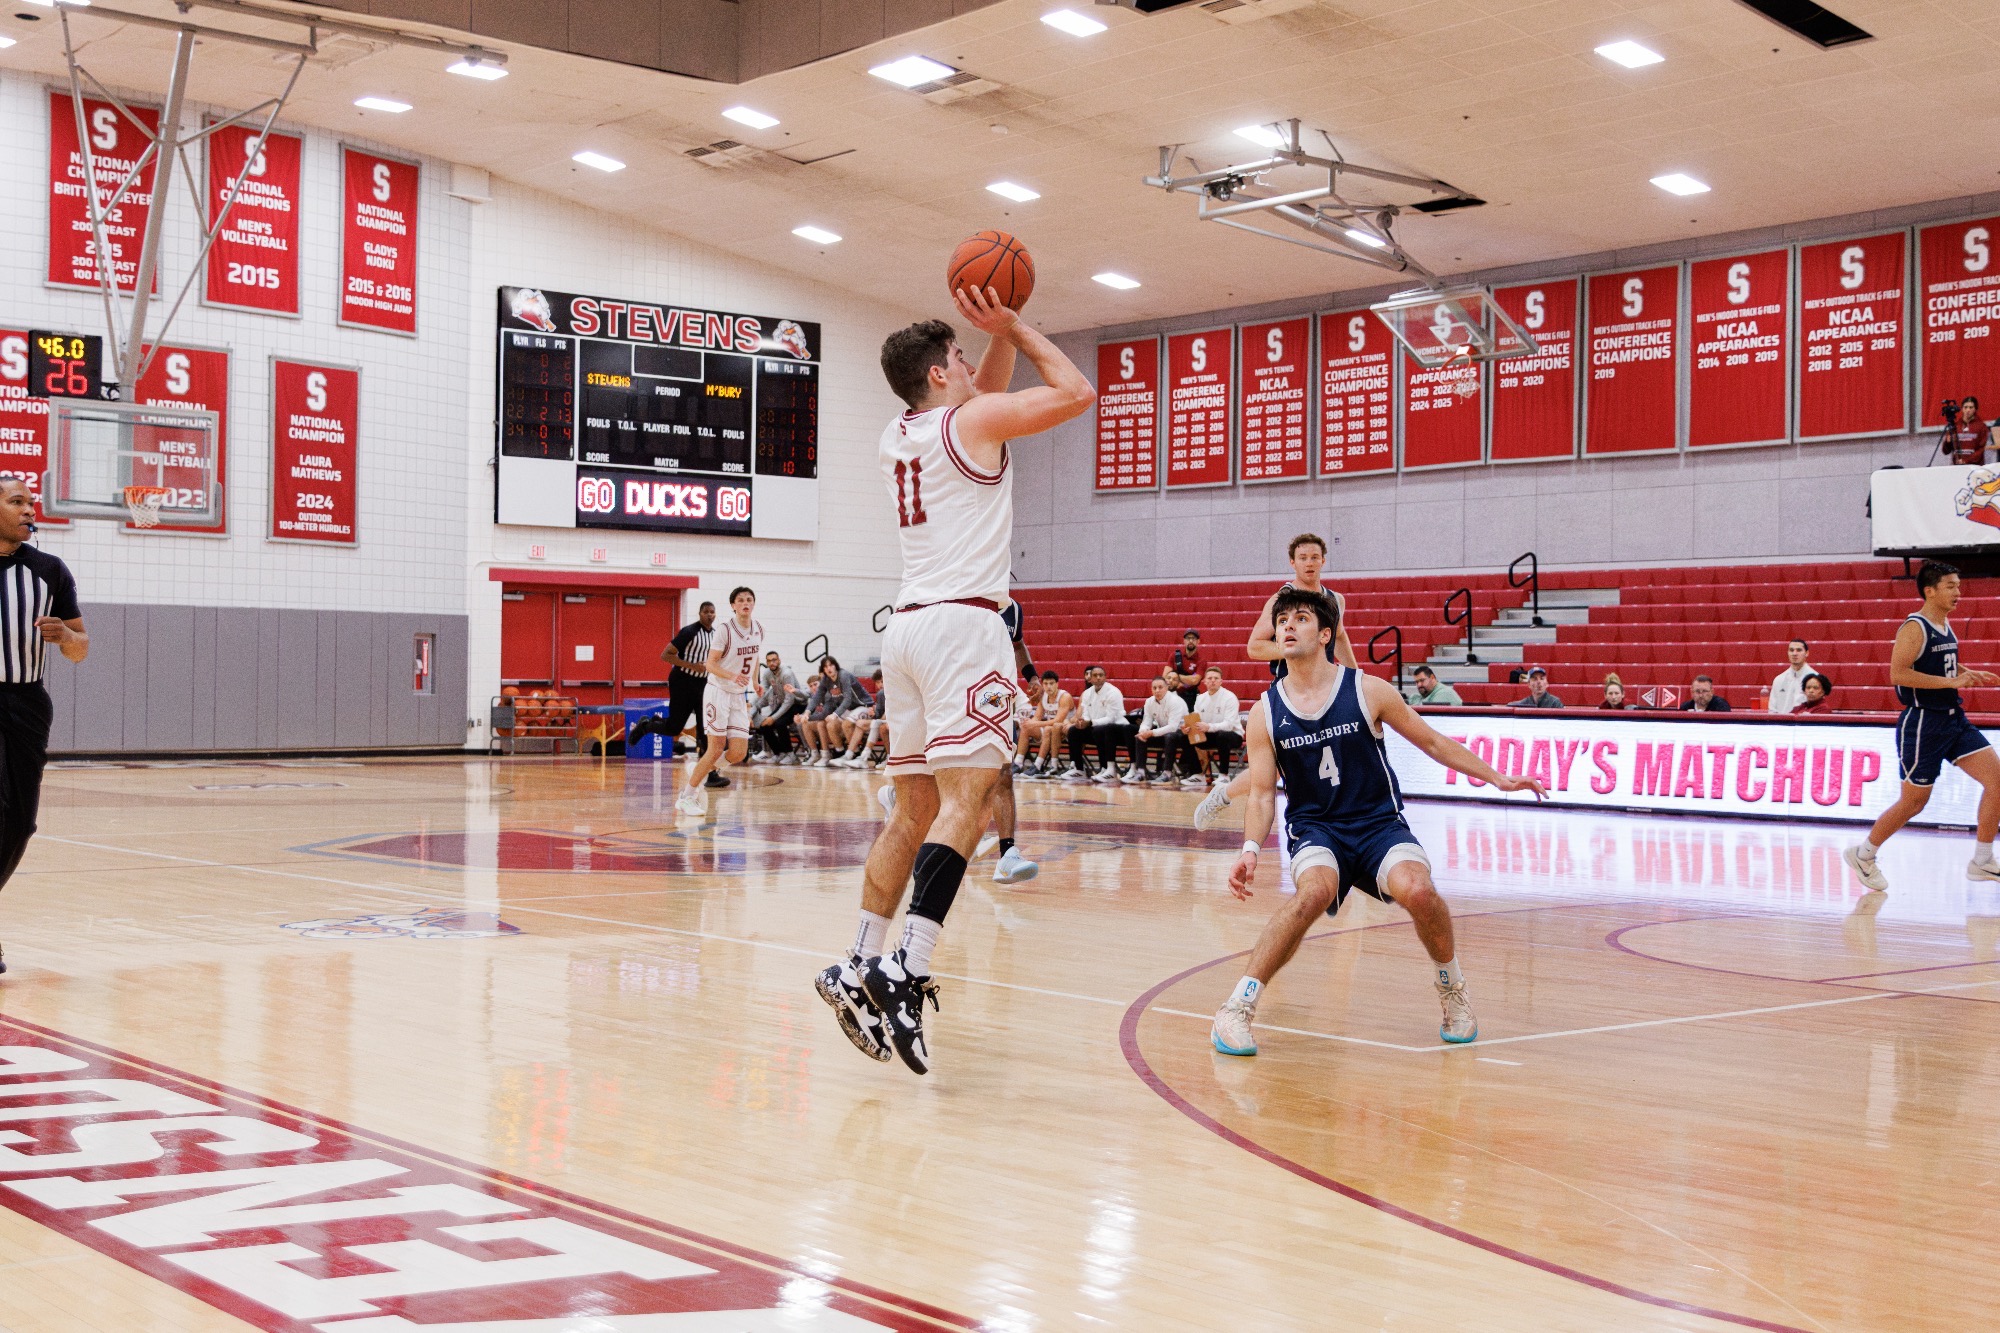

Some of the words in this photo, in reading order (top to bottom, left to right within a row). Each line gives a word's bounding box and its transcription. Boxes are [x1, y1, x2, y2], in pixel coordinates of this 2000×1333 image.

[92, 108, 118, 150] S
[244, 135, 267, 176] S
[372, 163, 391, 202] S
[357, 202, 405, 223] NATIONAL
[237, 218, 272, 235] MEN'S
[356, 214, 407, 236] CHAMPION
[221, 229, 288, 250] VOLLEYBALL
[363, 241, 398, 259] GLADYS
[1963, 227, 1989, 272] S
[72, 256, 93, 267] 200
[366, 254, 395, 271] NJOKU
[1840, 246, 1864, 290] S
[73, 269, 92, 280] 100
[227, 262, 280, 289] 2015
[1727, 262, 1750, 305] S
[347, 276, 375, 294] 2015
[376, 285, 384, 296] &
[385, 283, 412, 302] 2016
[1623, 278, 1643, 317] S
[345, 294, 374, 308] INDOOR
[374, 299, 393, 311] HIGH
[393, 303, 413, 315] JUMP
[1804, 299, 1825, 309] MEN'S
[1825, 295, 1855, 307] OUTDOOR
[1856, 291, 1876, 303] TRACK
[1883, 289, 1900, 300] FIELD
[1525, 290, 1545, 329] S
[1696, 312, 1715, 323] MEN'S
[1738, 307, 1757, 318] TRACK
[1763, 304, 1780, 315] FIELD
[1829, 306, 1874, 326] NCAA
[570, 297, 761, 353] STEVENS
[1434, 304, 1452, 339] S
[1635, 321, 1652, 331] TRACK
[1716, 321, 1758, 339] NCAA
[1348, 316, 1366, 352] S
[1807, 320, 1897, 342] APPEARANCES
[1929, 330, 1956, 343] 2018
[1963, 325, 1990, 339] 2019
[38, 337, 85, 359] 46.0
[535, 338, 547, 348] FLS
[555, 339, 567, 350] PTS
[1266, 327, 1284, 363] S
[1593, 331, 1671, 351] CONFERENCE
[1697, 334, 1780, 354] APPEARANCES
[1808, 344, 1832, 357] 2012
[1839, 341, 1863, 353] 2015
[1870, 337, 1895, 350] 2016
[0, 335, 28, 380] S
[1120, 346, 1135, 380] S
[1191, 337, 1207, 372] S
[1328, 356, 1361, 368] WOMEN'S
[1361, 352, 1386, 363] TENNIS
[1593, 345, 1671, 365] CHAMPIONS
[1697, 357, 1720, 369] 2014
[1726, 353, 1749, 366] 2018
[1755, 350, 1778, 363] 2019
[784, 363, 793, 374] FLS
[1254, 366, 1273, 376] MEN'S
[1273, 364, 1295, 374] TENNIS
[1325, 363, 1389, 382] CONFERENCE
[1499, 356, 1570, 375] CHAMPIONS
[1808, 359, 1832, 372] 2018
[1839, 356, 1863, 369] 2021
[46, 358, 88, 395] 26
[166, 352, 191, 395] S
[587, 373, 631, 388] STEVENS
[1180, 376, 1197, 385] MEN'S
[1197, 373, 1218, 383] TENNIS
[1500, 377, 1519, 388] 2019
[1522, 375, 1544, 386] 2020
[1594, 368, 1615, 380] 2019
[306, 371, 328, 412] S
[655, 385, 680, 398] PERIOD
[706, 384, 742, 399] M'BURY
[1108, 383, 1126, 392] MEN'S
[1126, 381, 1146, 390] TENNIS
[1172, 384, 1226, 399] CONFERENCE
[1259, 376, 1289, 392] NCAA
[1325, 376, 1389, 395] CHAMPIONS
[1410, 387, 1429, 398] 2019
[1433, 384, 1452, 396] 2022
[1100, 391, 1154, 406] CONFERENCE
[1172, 395, 1226, 412] CHAMPIONS
[1245, 388, 1304, 404] APPEARANCES
[1410, 400, 1430, 412] 2024
[1433, 398, 1452, 409] 2025
[1100, 403, 1154, 417] CHAMPIONS
[1369, 404, 1387, 415] 1992
[290, 414, 343, 431] NATIONAL
[540, 424, 548, 439] 0
[586, 417, 611, 429] FOULS
[618, 420, 637, 431] T.O.L.
[643, 422, 670, 434] PLAYER
[673, 424, 691, 435] FOUL
[697, 426, 716, 438] T.O.L.
[723, 429, 745, 440] FOULS
[288, 427, 345, 444] CHAMPION
[159, 440, 197, 455] MEN'S
[808, 446, 815, 460] 0
[1325, 447, 1344, 458] 2022
[1347, 445, 1366, 456] 2023
[1369, 443, 1388, 454] 2024
[299, 454, 332, 468] LAURA
[586, 452, 610, 463] SCORE
[654, 457, 679, 468] MATCH
[1325, 460, 1344, 470] 2025
[291, 466, 342, 482] MATHEWS
[722, 463, 744, 473] SCORE
[783, 461, 795, 475] 10
[578, 477, 615, 513] GO
[624, 480, 708, 518] DUCKS
[717, 487, 751, 521] GO
[894, 454, 927, 528] 11
[296, 492, 334, 510] 2024
[298, 511, 332, 523] OUTDOOR
[318, 522, 351, 534] HURDLES
[531, 545, 545, 557] EXIT
[593, 548, 606, 560] EXIT
[654, 553, 667, 564] EXIT
[737, 645, 759, 656] DUCKS
[741, 657, 752, 675] 5
[1279, 721, 1359, 750] MIDDLEBURY
[1318, 745, 1341, 787] 4
[1446, 734, 1618, 794] TODAY'S
[1632, 741, 1881, 806] MATCHUP
